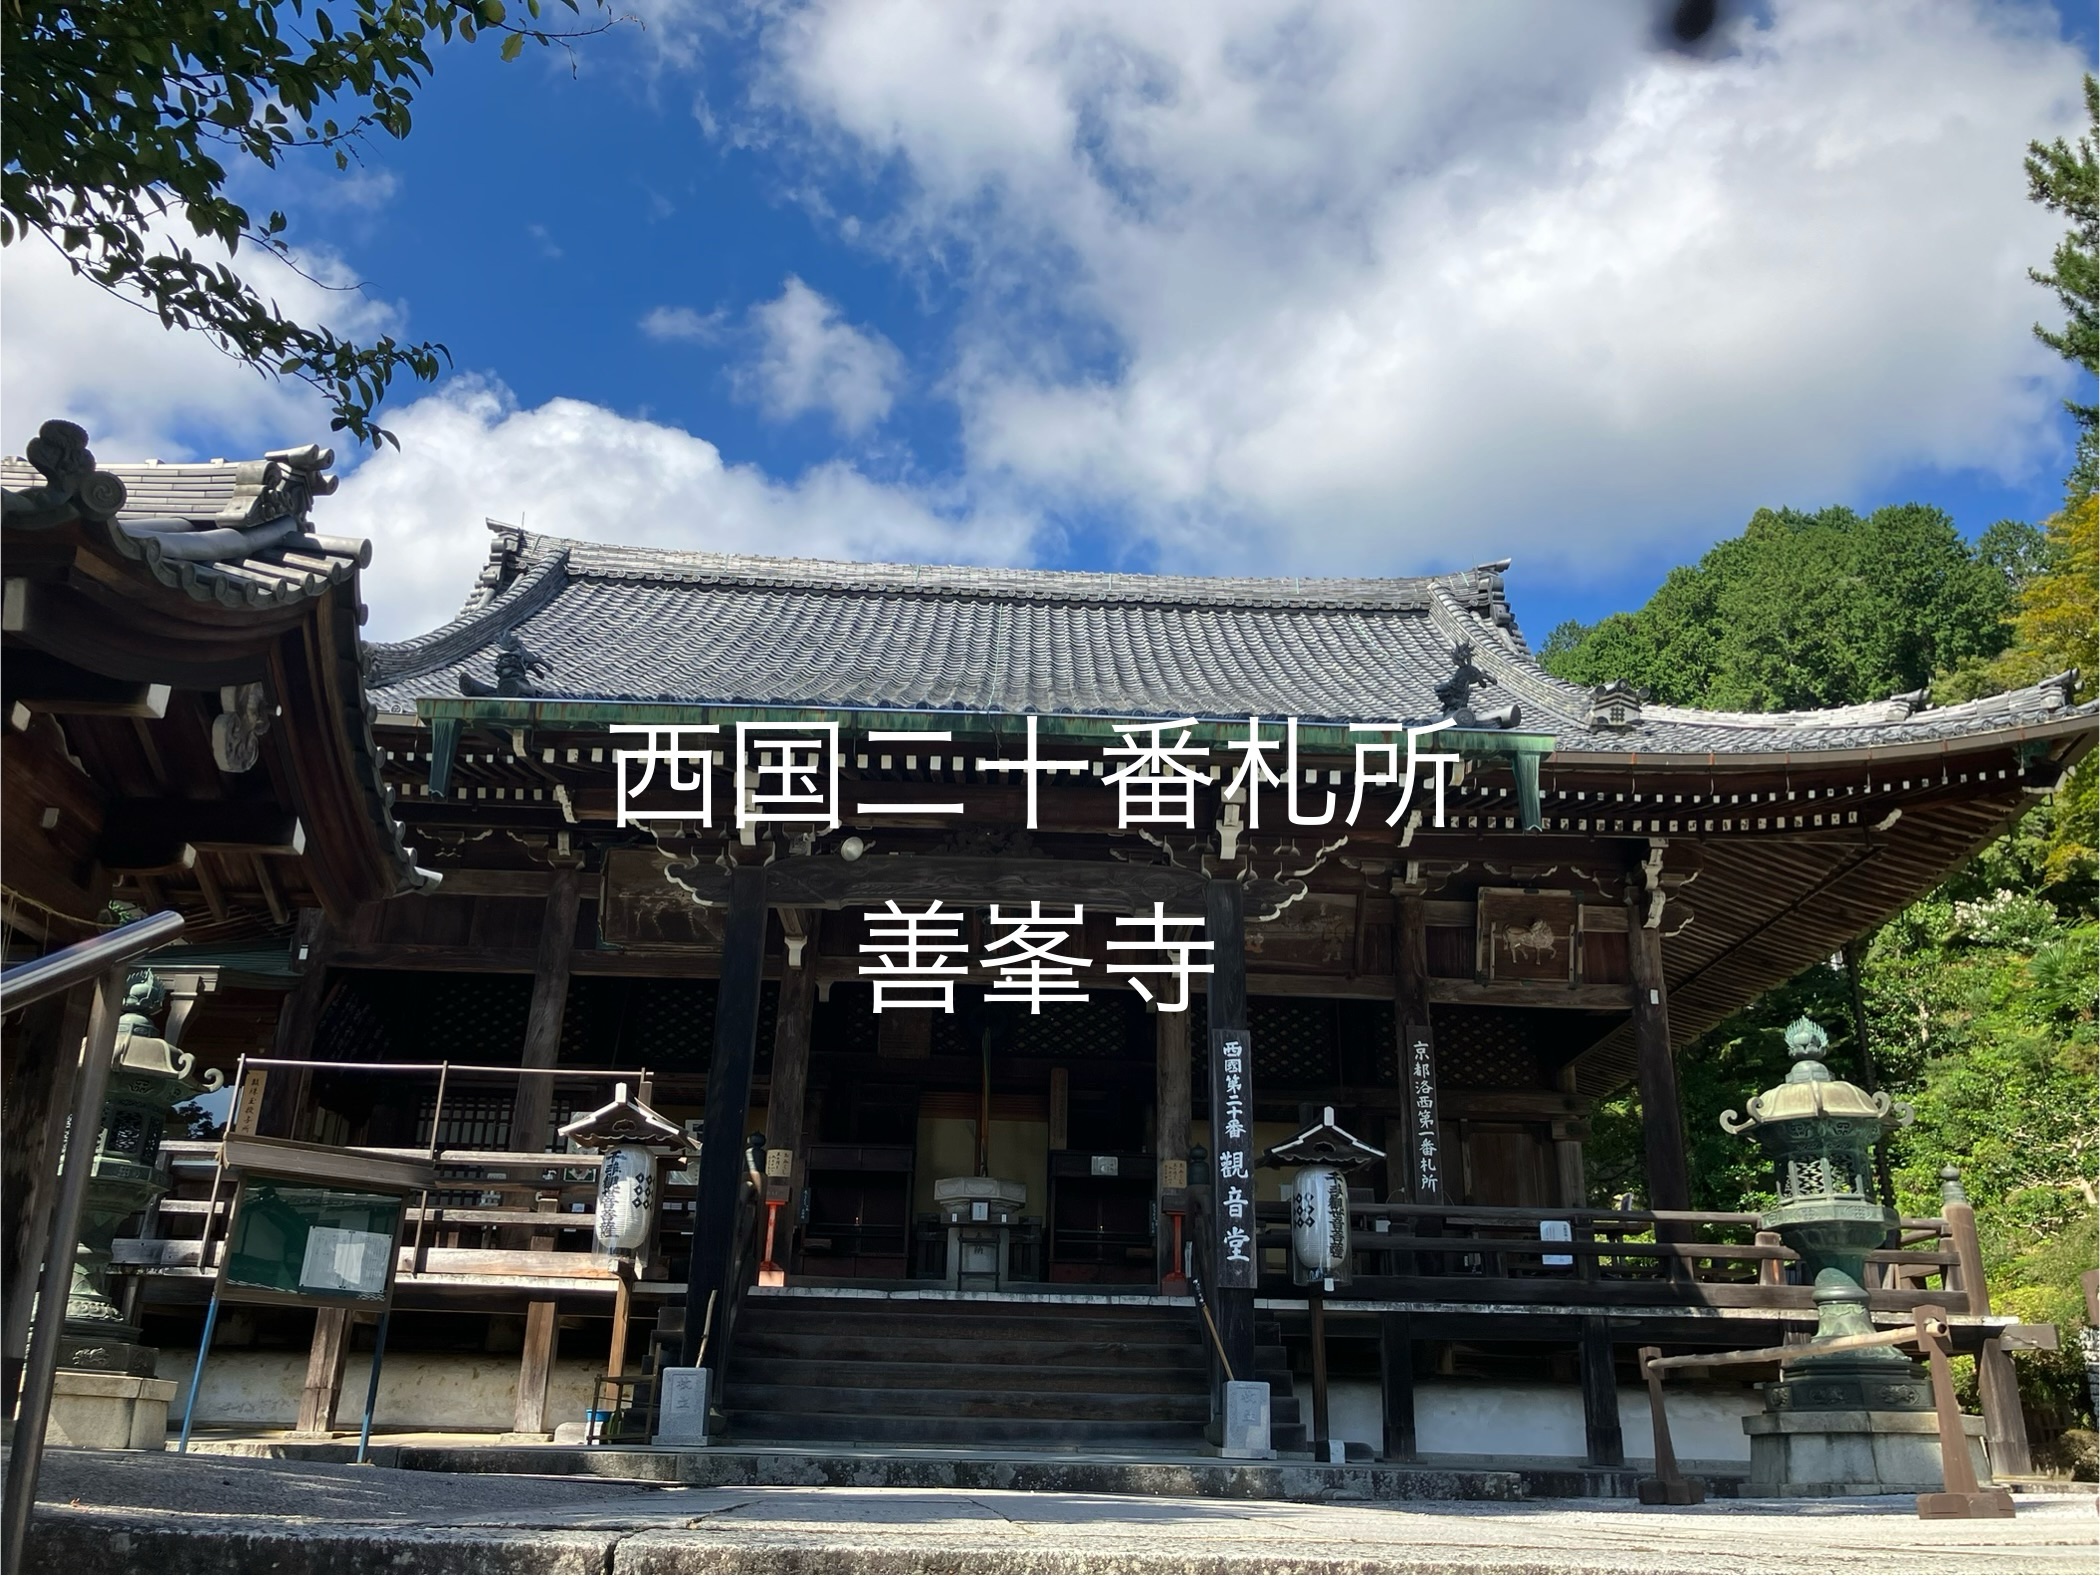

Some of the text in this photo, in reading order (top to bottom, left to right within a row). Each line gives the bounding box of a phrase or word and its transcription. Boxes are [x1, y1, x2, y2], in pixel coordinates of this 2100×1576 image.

[1219, 1041, 1250, 1262] 西國第二十番 觀音堂
[1413, 1040, 1438, 1193] 京都洛西第一番札所
